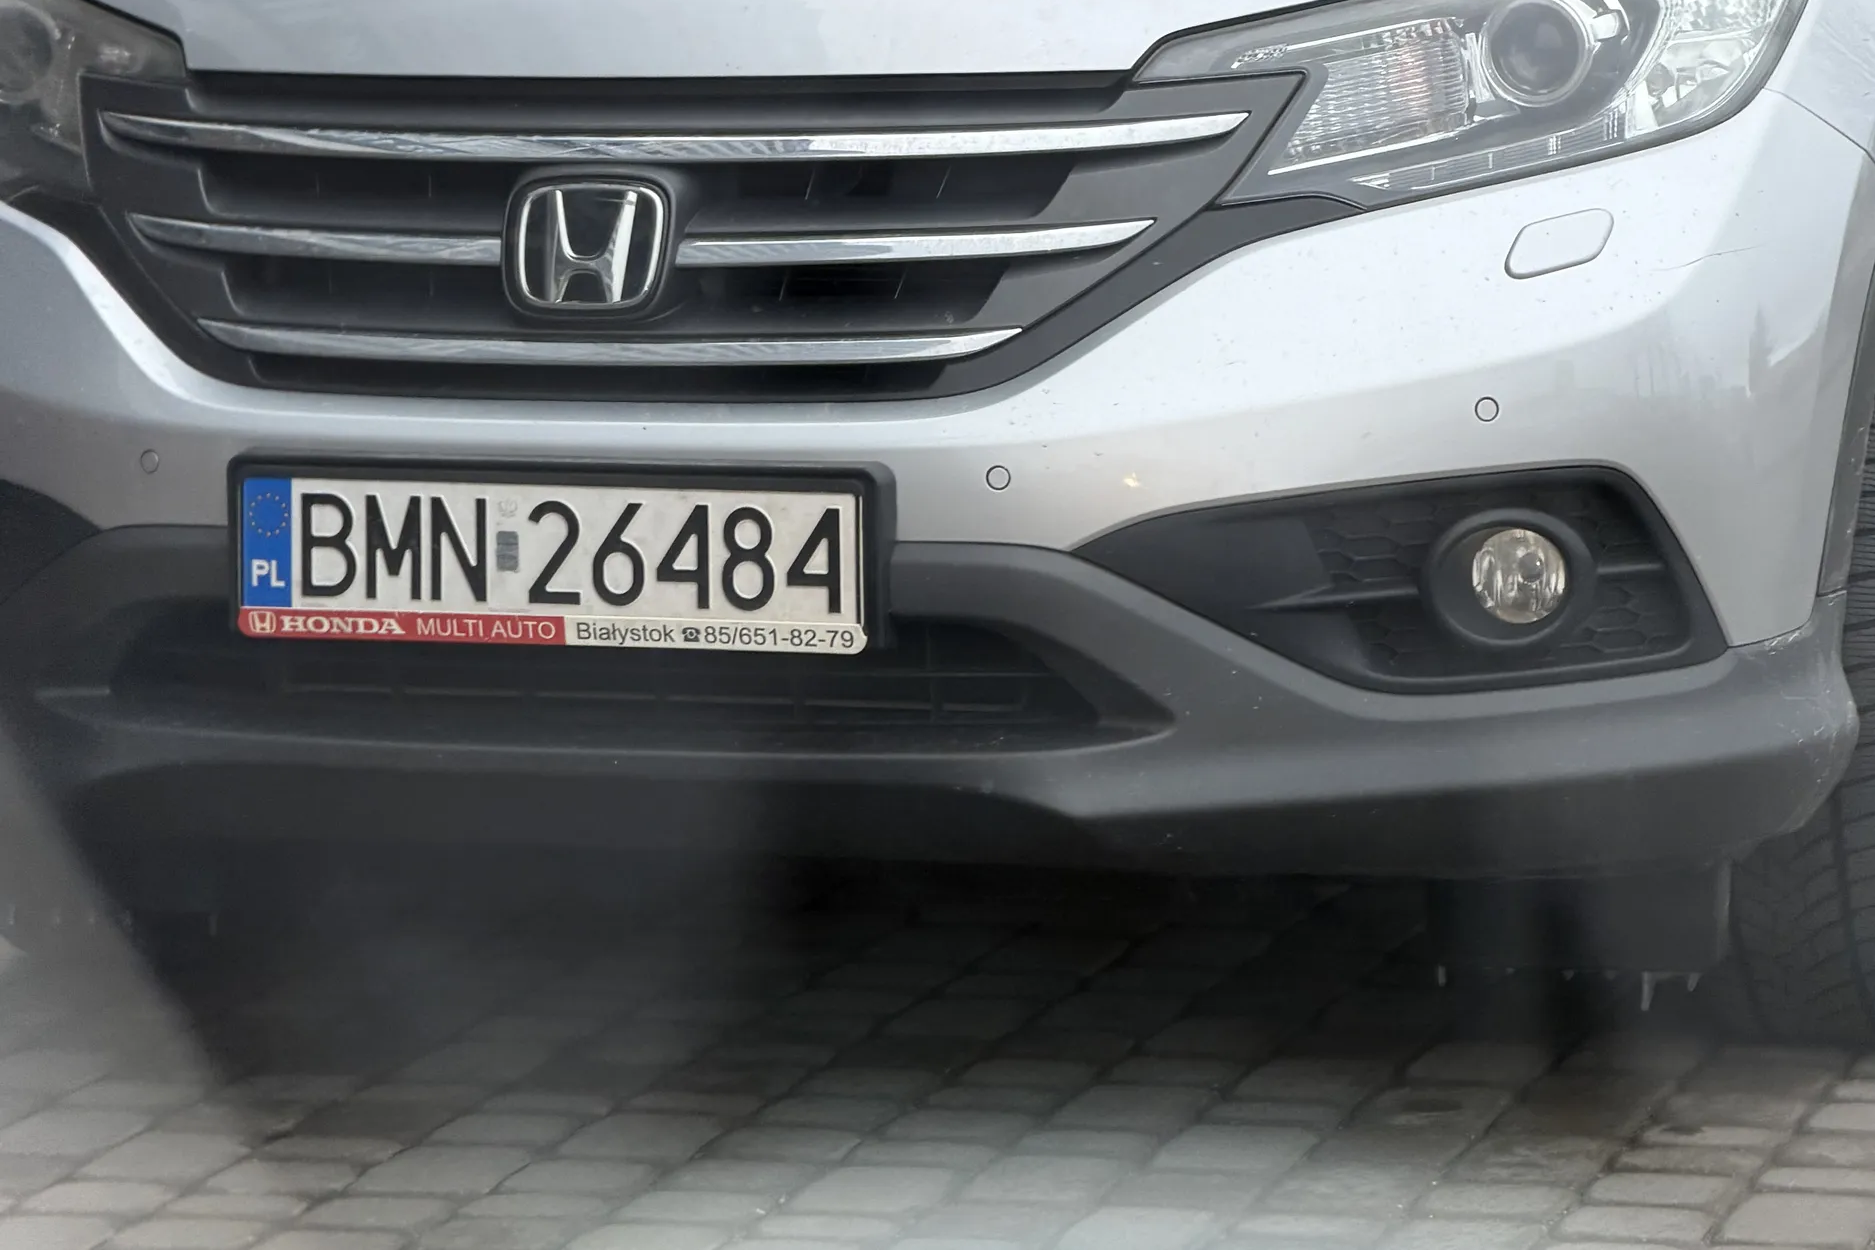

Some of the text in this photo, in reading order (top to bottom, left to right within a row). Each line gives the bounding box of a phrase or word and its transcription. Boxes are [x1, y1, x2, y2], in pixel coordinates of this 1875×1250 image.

[301, 492, 842, 614] BMN 26484
[251, 558, 285, 588] PL
[280, 614, 406, 635] HONDA
[416, 617, 484, 637] MULTI
[491, 619, 556, 640] AUTO
[576, 622, 676, 645] Białystok
[704, 625, 855, 649] 85/651-82-79
